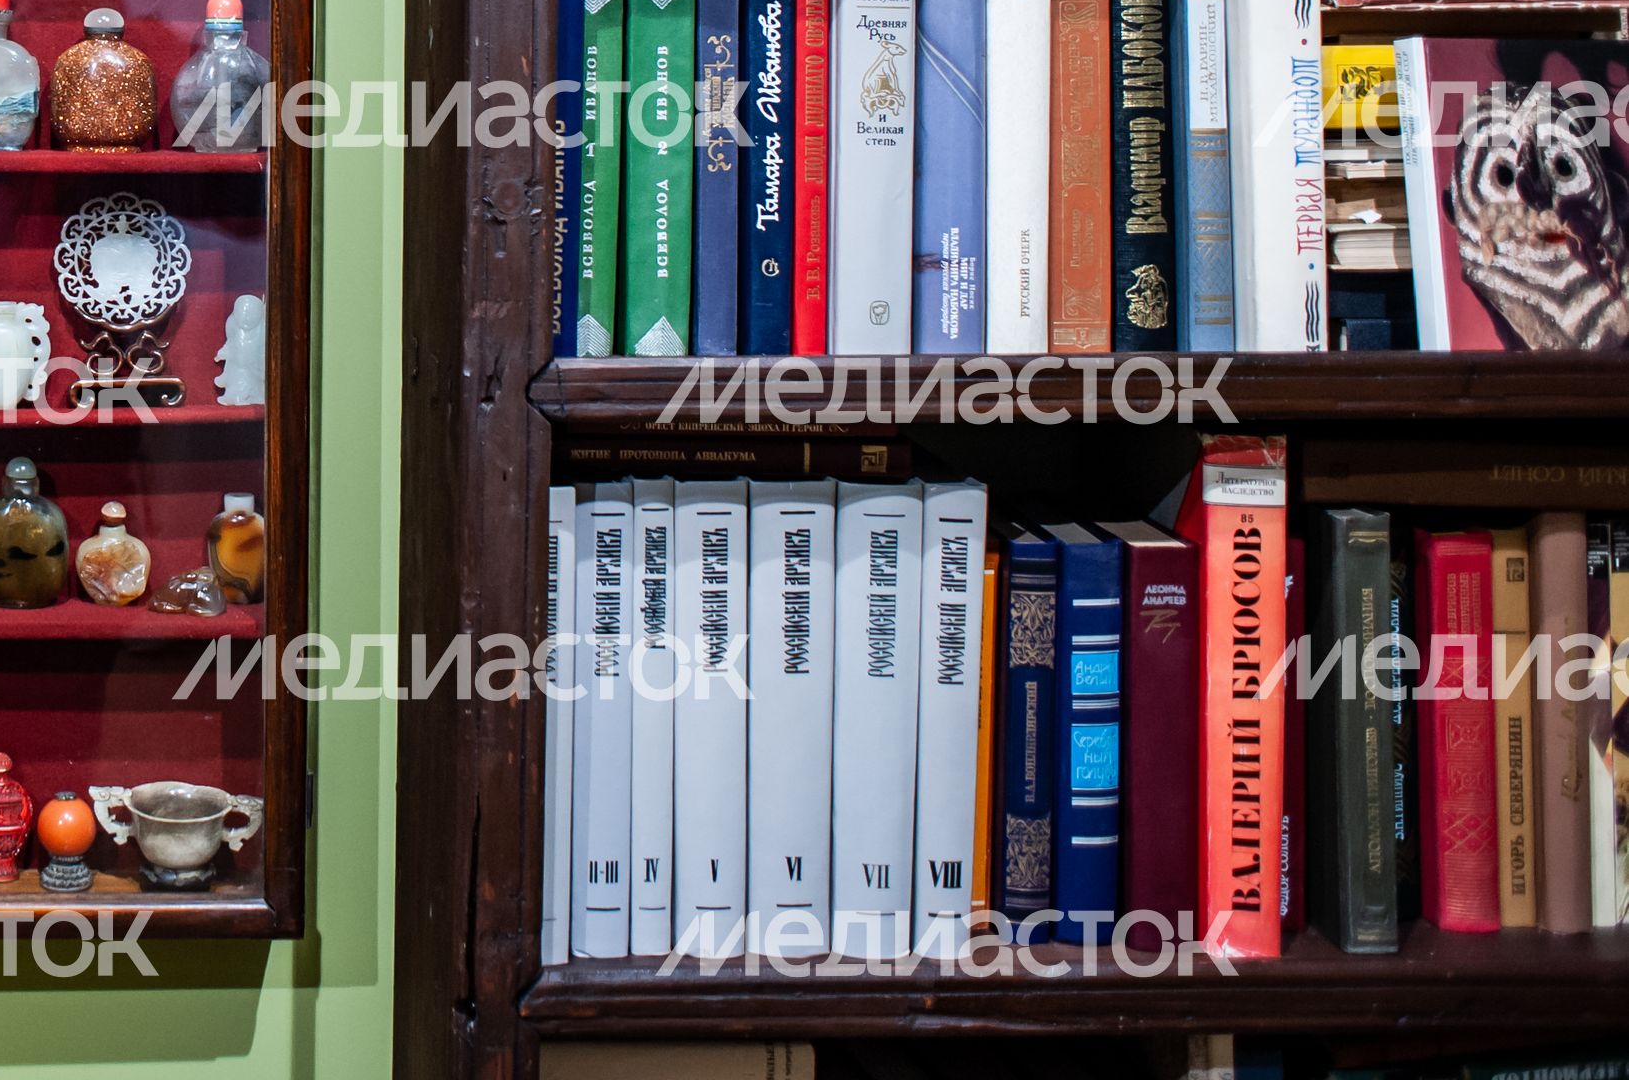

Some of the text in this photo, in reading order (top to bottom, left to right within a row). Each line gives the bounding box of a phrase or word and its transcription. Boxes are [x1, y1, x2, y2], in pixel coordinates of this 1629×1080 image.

[856, 15, 907, 31] Древняя
[868, 28, 896, 43] Русь
[1206, 3, 1218, 123] МИХАЙЛОВСКИЙ
[755, 0, 783, 231] Тамара Иванова
[857, 122, 904, 134] Великая
[879, 114, 886, 122] и
[865, 136, 896, 146] степь
[581, 45, 598, 279] ВСЕВОЛОД 1 ИВАНОВ
[656, 45, 669, 279] ВСЕВОЛОД 2 ИВАНОВ
[804, 136, 824, 184] ЛЮДИ
[1125, 117, 1168, 234] Владимир
[1294, 179, 1324, 255] ПЕРВАЯ
[959, 257, 969, 279] МИР
[1018, 228, 1031, 318] РУССКИЙ ОЧЕРК
[940, 233, 951, 334] первая русская биография
[950, 227, 960, 340] ВЛАДИМИРА НАБОКОВА
[959, 291, 969, 310] ДАР
[619, 449, 756, 462] ПРОТОПОПА АВВАКУМА
[1221, 487, 1275, 496] НАСЛЕДСТВО
[1240, 514, 1255, 523] 85
[1142, 595, 1187, 605] АНДРЕЕВ
[1144, 584, 1186, 594] ЛЕОНИД
[1227, 528, 1262, 913] ВАЛЕРИЙ БРЮСОВ
[1508, 716, 1526, 896] ИГОРЬ СЕВЕРЯНИН
[589, 860, 618, 883] II-III
[643, 858, 659, 882] IV
[710, 858, 719, 883] V
[785, 856, 802, 881] VI
[862, 863, 891, 888] VII
[928, 860, 963, 888] VIII
